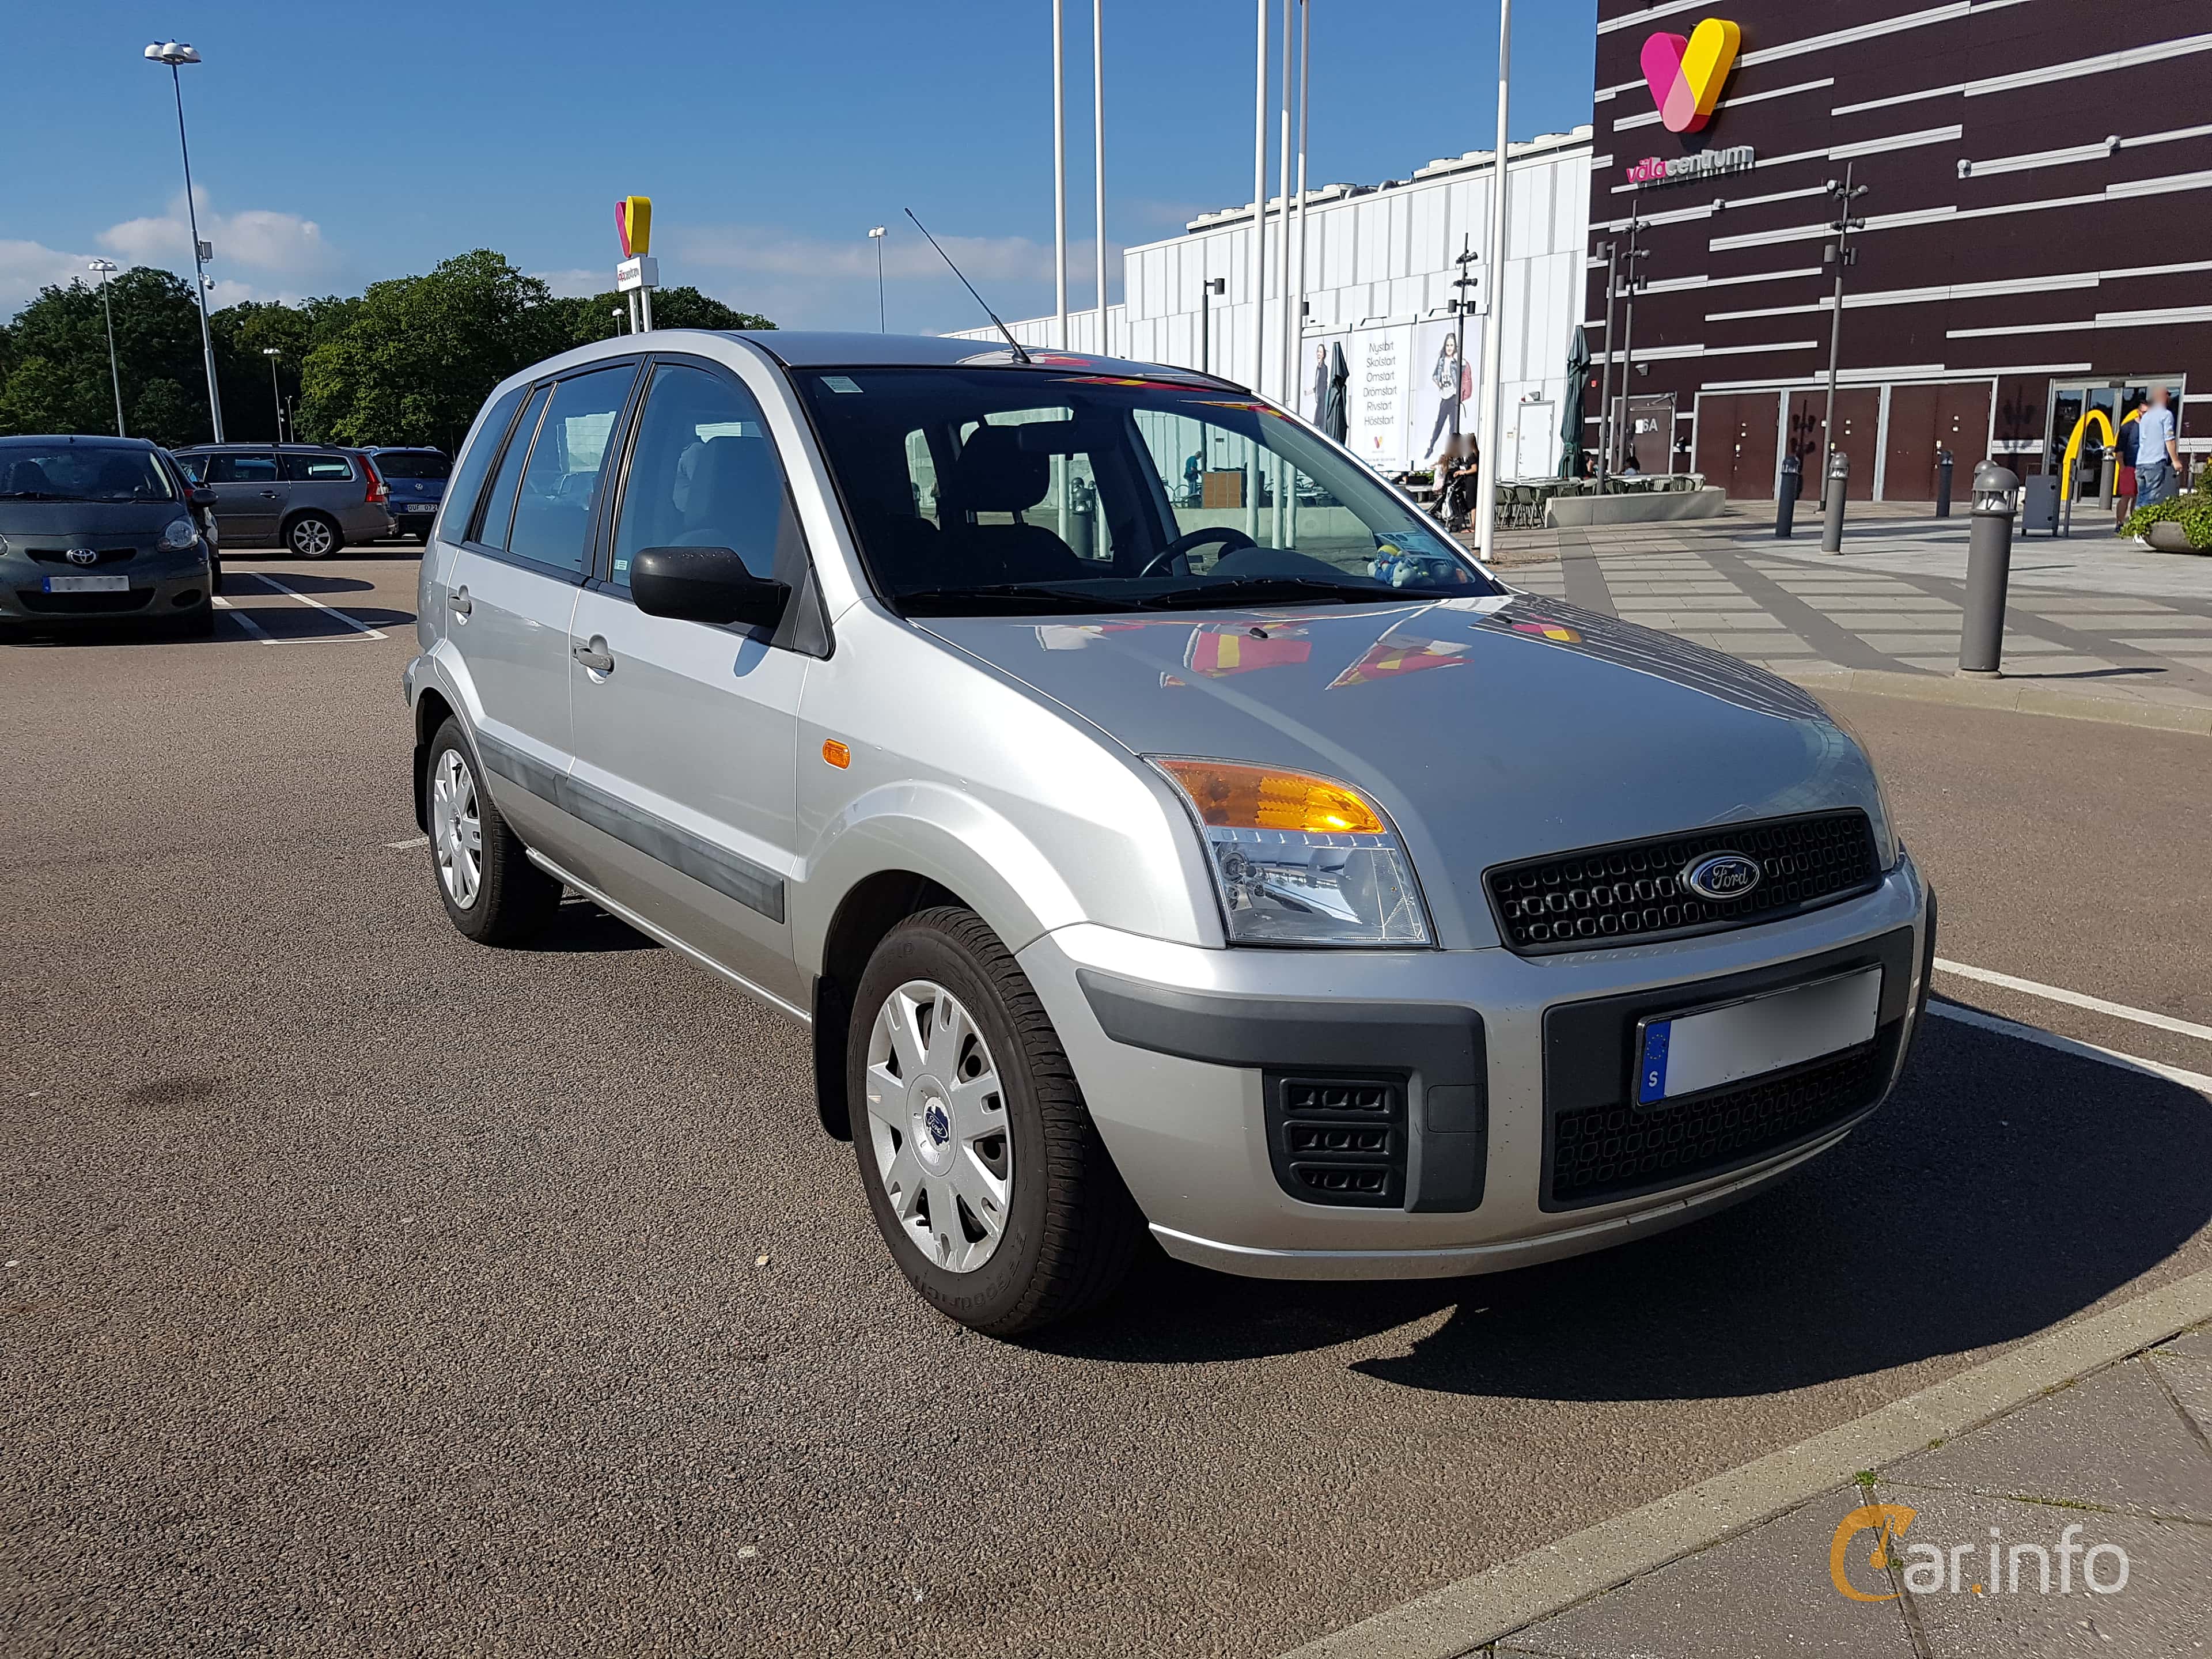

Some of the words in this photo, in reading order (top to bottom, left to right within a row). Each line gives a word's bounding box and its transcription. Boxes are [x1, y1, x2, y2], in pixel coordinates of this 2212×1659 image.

[1626, 145, 1754, 183] välacentrum
[1369, 341, 1394, 355] Nystart
[1366, 355, 1396, 368] Skolstart
[1366, 370, 1395, 382] Omstart
[1363, 385, 1397, 397] Drömstart
[1367, 400, 1392, 412] Rivstart
[1364, 415, 1394, 426] Höststart
[1711, 863, 1748, 889] Ford
[1649, 1071, 1658, 1087] S
[928, 1115, 944, 1134] Ford
